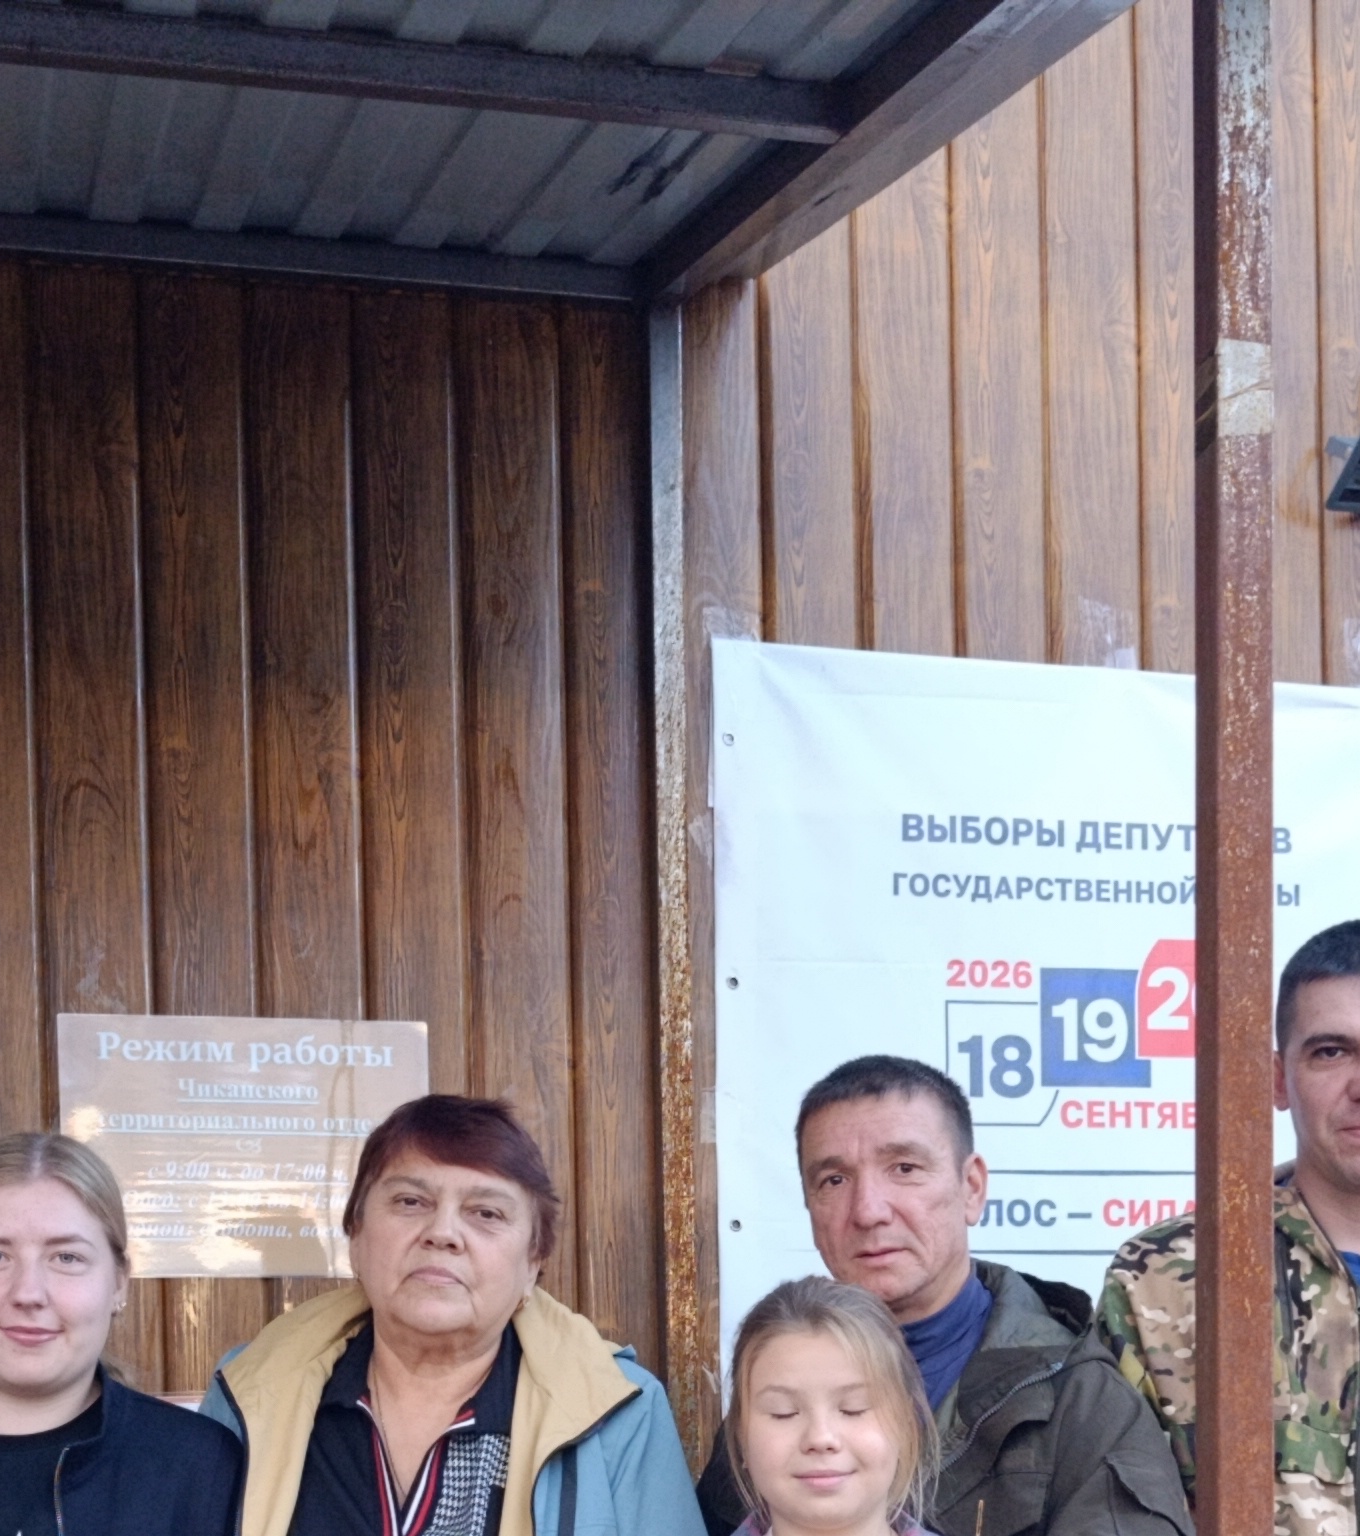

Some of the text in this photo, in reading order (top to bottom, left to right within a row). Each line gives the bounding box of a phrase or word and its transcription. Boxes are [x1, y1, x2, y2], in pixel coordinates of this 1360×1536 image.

[900, 813, 1066, 849] ВЫБОРЫ
[891, 872, 1197, 906] ГОСУДАРСТВЕННОЙ
[946, 958, 1033, 989] 2026
[956, 966, 1197, 1099] 18 19 2
[95, 1031, 395, 1073] Режим работы
[178, 1077, 319, 1100] Чиканского
[99, 1112, 372, 1134] ерриториального отде
[1060, 1100, 1197, 1130] СЕНТЯ
[148, 1166, 159, 1179] с
[166, 1161, 210, 1179] 9:00
[273, 1162, 327, 1181] 17:00
[979, 1199, 1058, 1227] ЛОС
[1102, 1199, 1197, 1227] СИЛ
